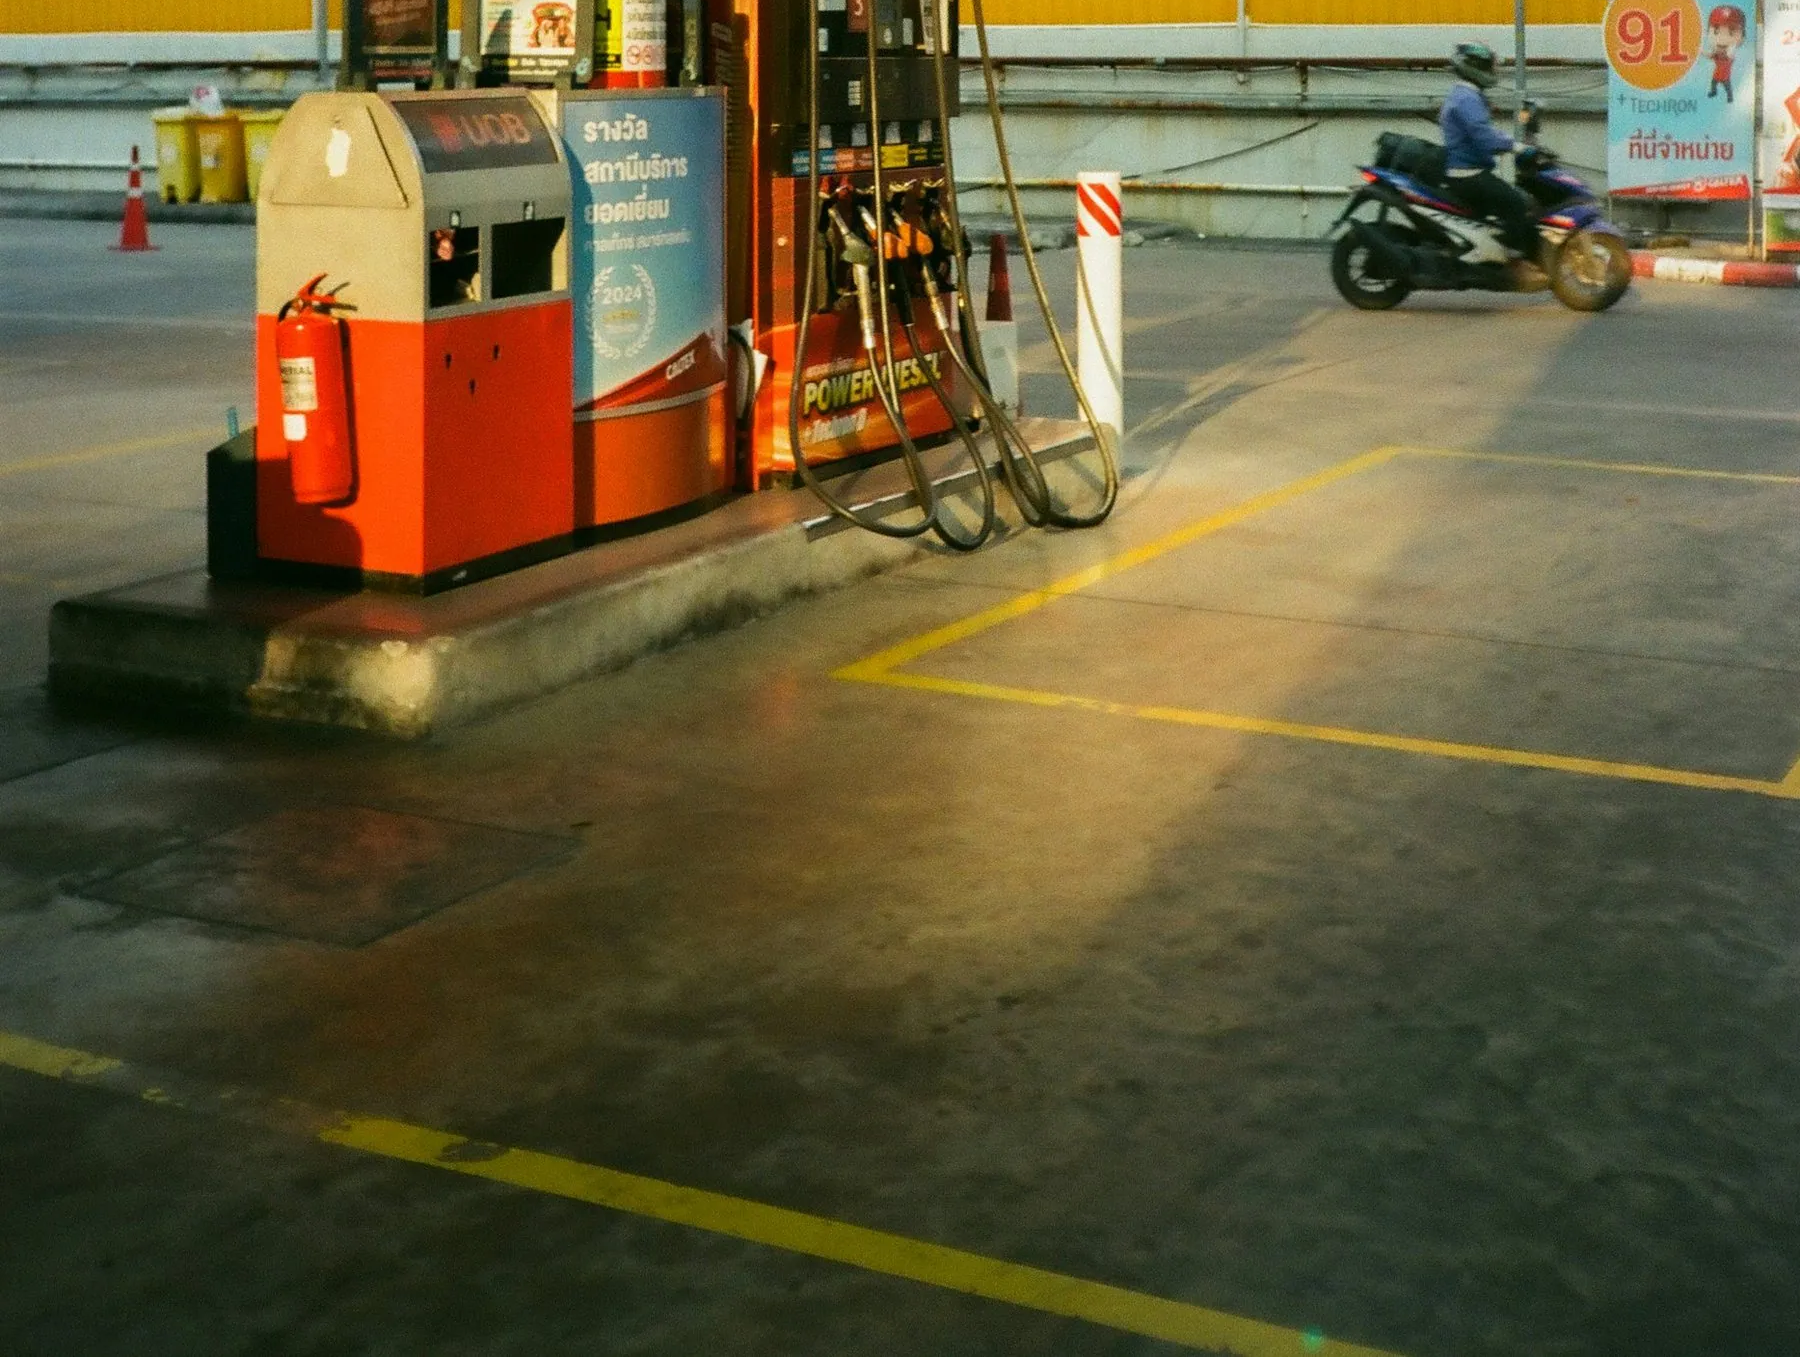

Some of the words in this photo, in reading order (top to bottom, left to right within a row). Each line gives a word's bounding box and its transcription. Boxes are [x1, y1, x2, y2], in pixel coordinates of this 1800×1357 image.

[1616, 9, 1688, 64] 91
[584, 113, 648, 143] รางวัล
[584, 152, 688, 184] สถานีบริการ
[584, 184, 670, 224] ยอดเยี่ยม
[601, 285, 642, 305] 2024
[803, 368, 874, 416] POWER
